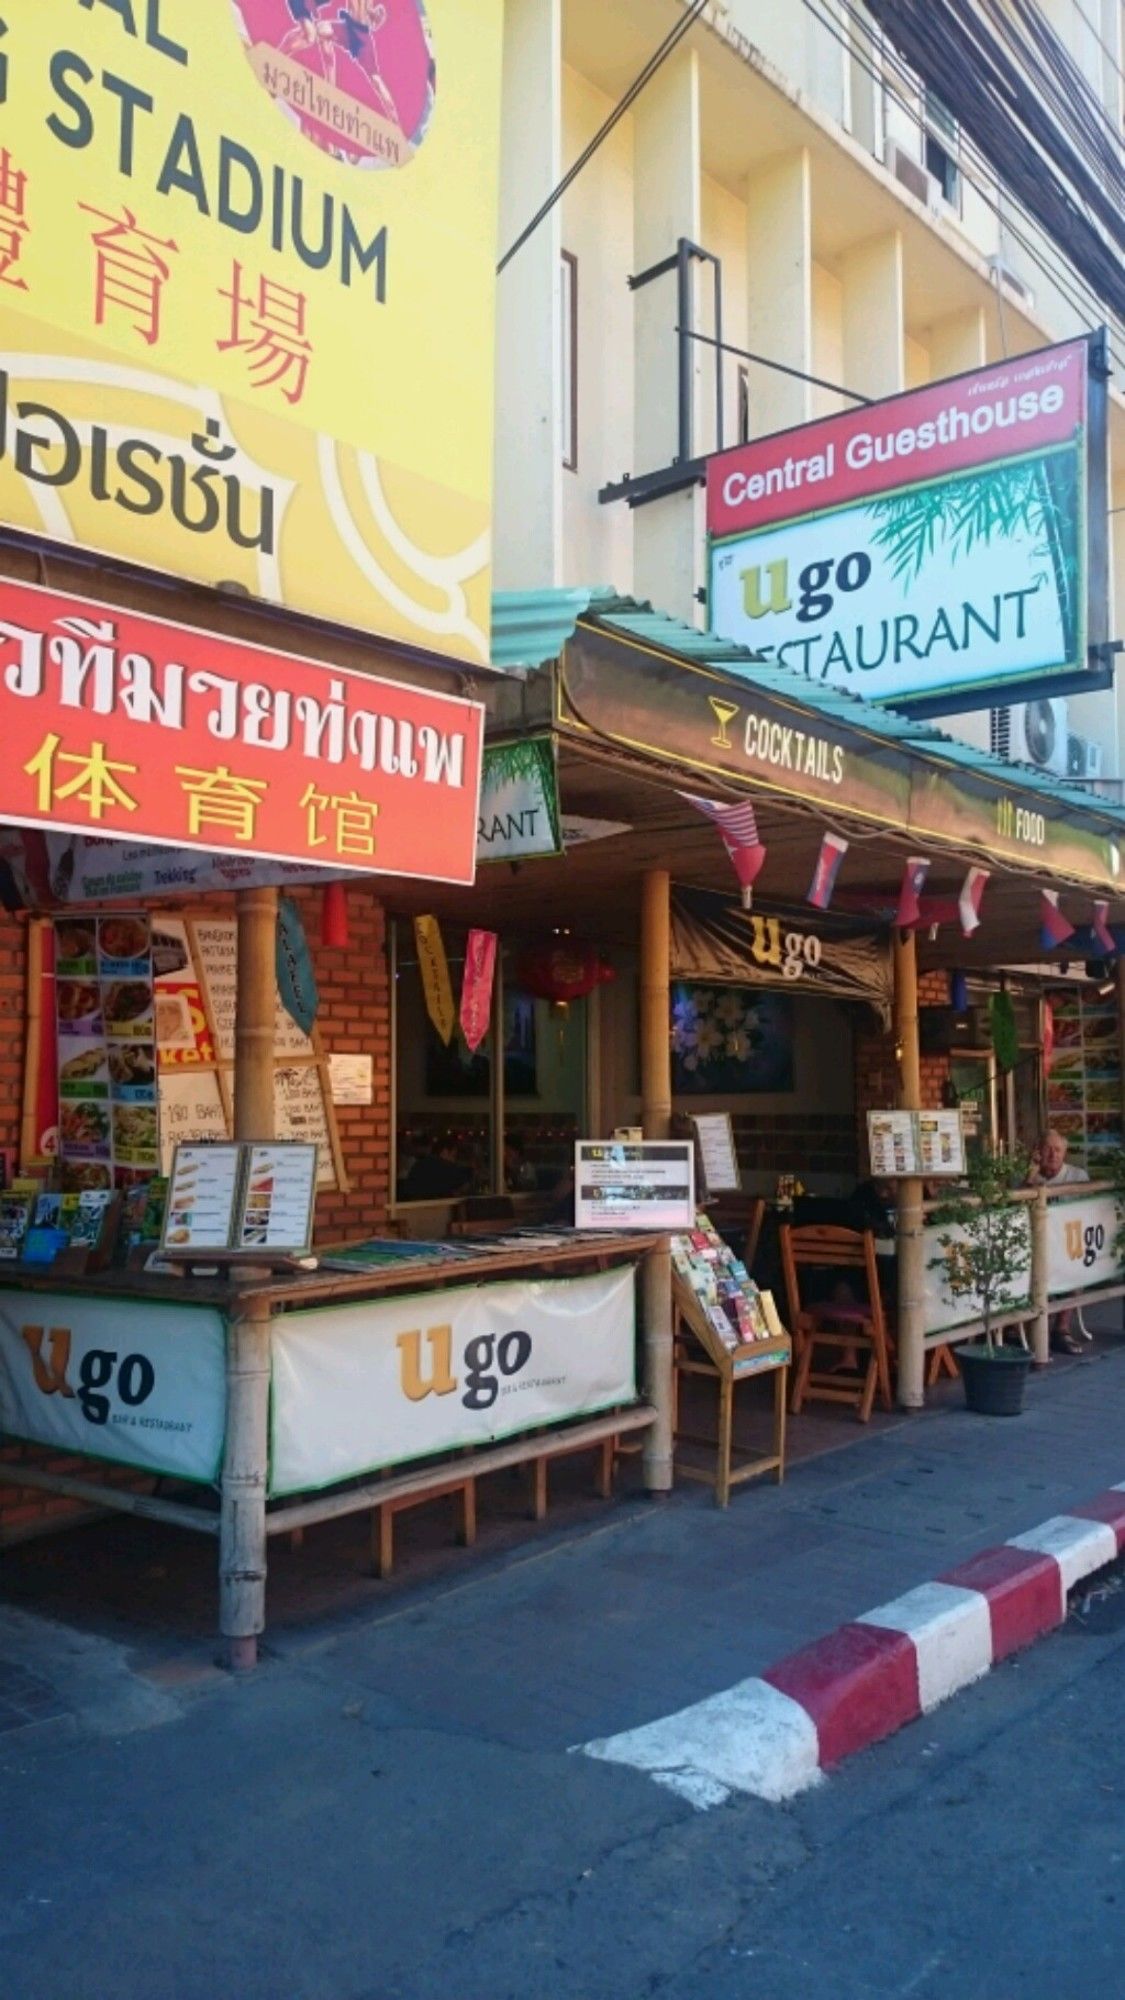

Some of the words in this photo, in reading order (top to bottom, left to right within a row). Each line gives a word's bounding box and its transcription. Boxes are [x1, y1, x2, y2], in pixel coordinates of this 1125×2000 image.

[45, 50, 388, 304] STADIUM
[722, 445, 834, 507] Central
[845, 384, 1064, 470] Guesthouse
[739, 552, 872, 623] ugo
[744, 713, 844, 785] COCKTAILS
[24, 732, 378, 856] 体育馆
[1016, 808, 1045, 846] FOOD
[750, 915, 822, 979] ugo
[1064, 1218, 1105, 1268] ugo
[21, 1325, 155, 1425] ugo
[396, 1324, 533, 1411] ugo
